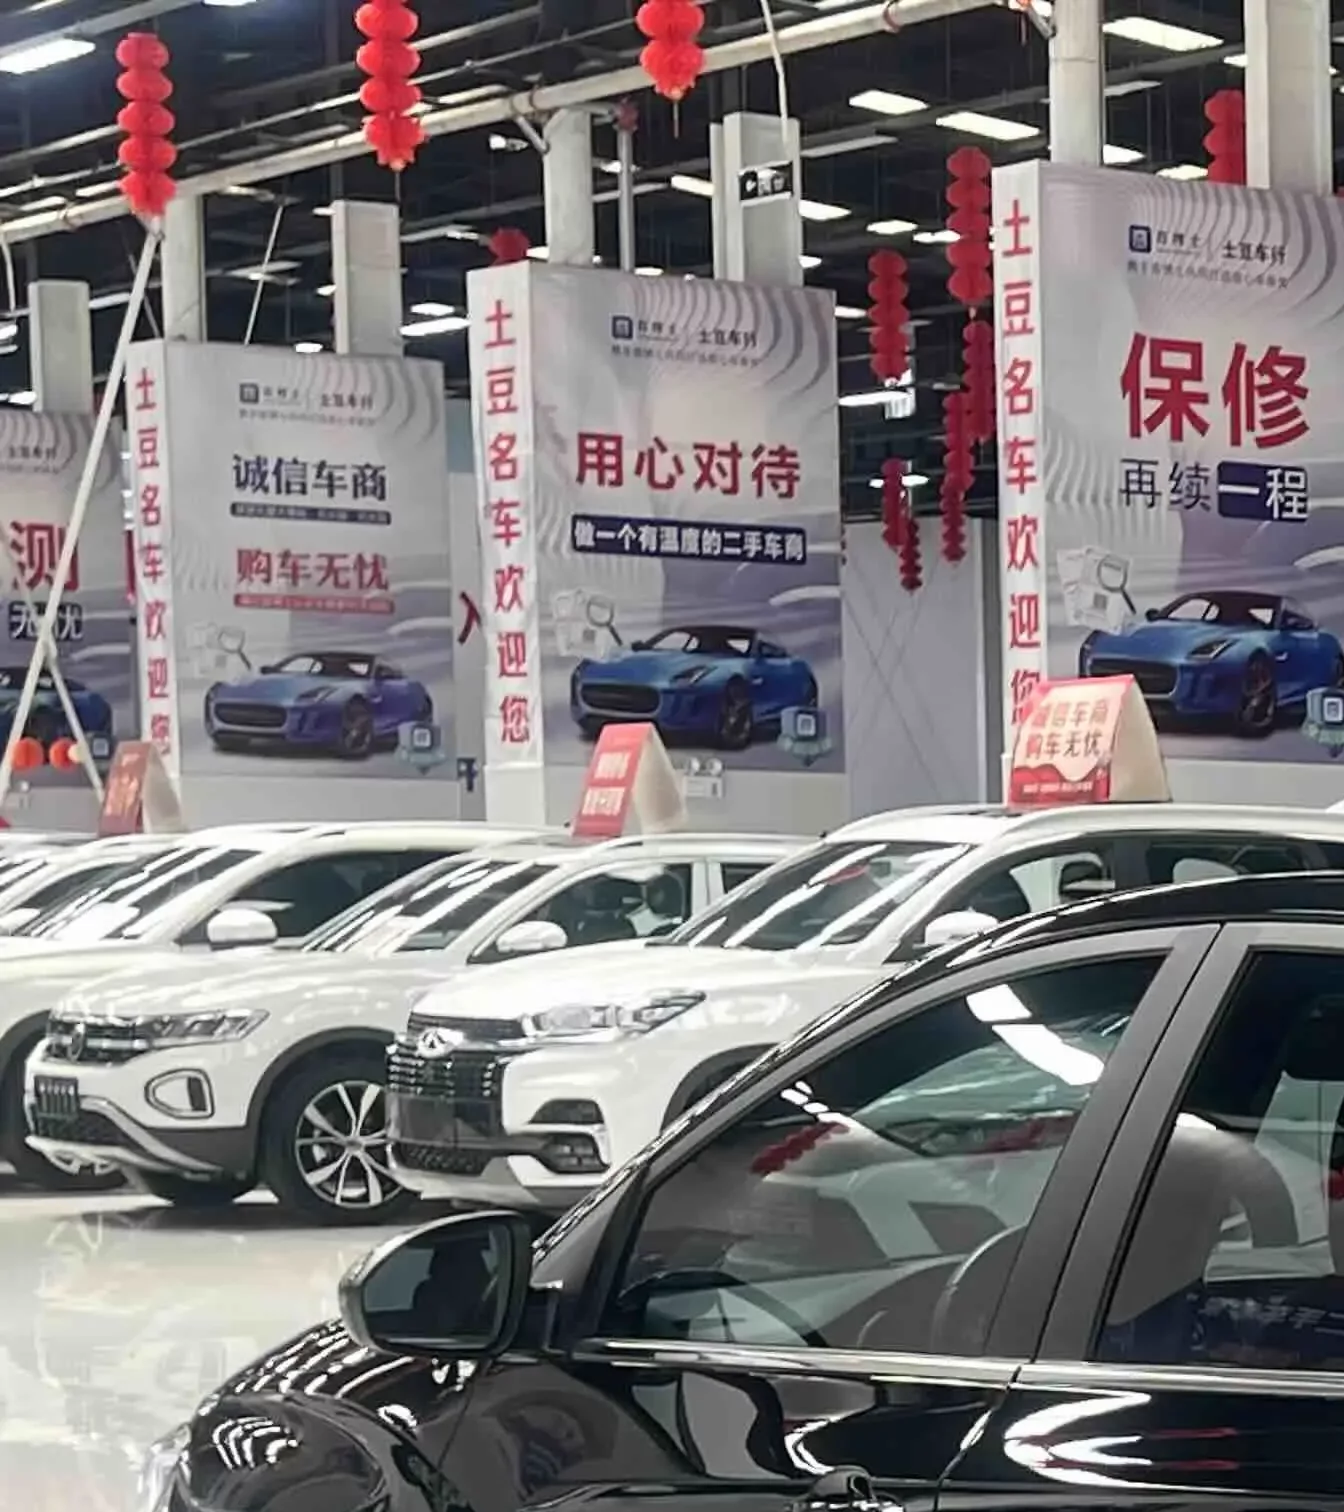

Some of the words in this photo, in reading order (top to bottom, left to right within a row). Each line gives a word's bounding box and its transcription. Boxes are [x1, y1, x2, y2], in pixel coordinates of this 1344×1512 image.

[1119, 331, 1311, 450] 保修
[233, 453, 387, 502] 诚信车商
[575, 430, 802, 501] 用心对待
[1119, 458, 1310, 521] 再续一程
[10, 521, 80, 592] 测
[484, 299, 530, 746] 土豆名车欢迎您
[134, 367, 173, 756] 土豆名车欢迎您
[237, 549, 389, 590] 购车无忧
